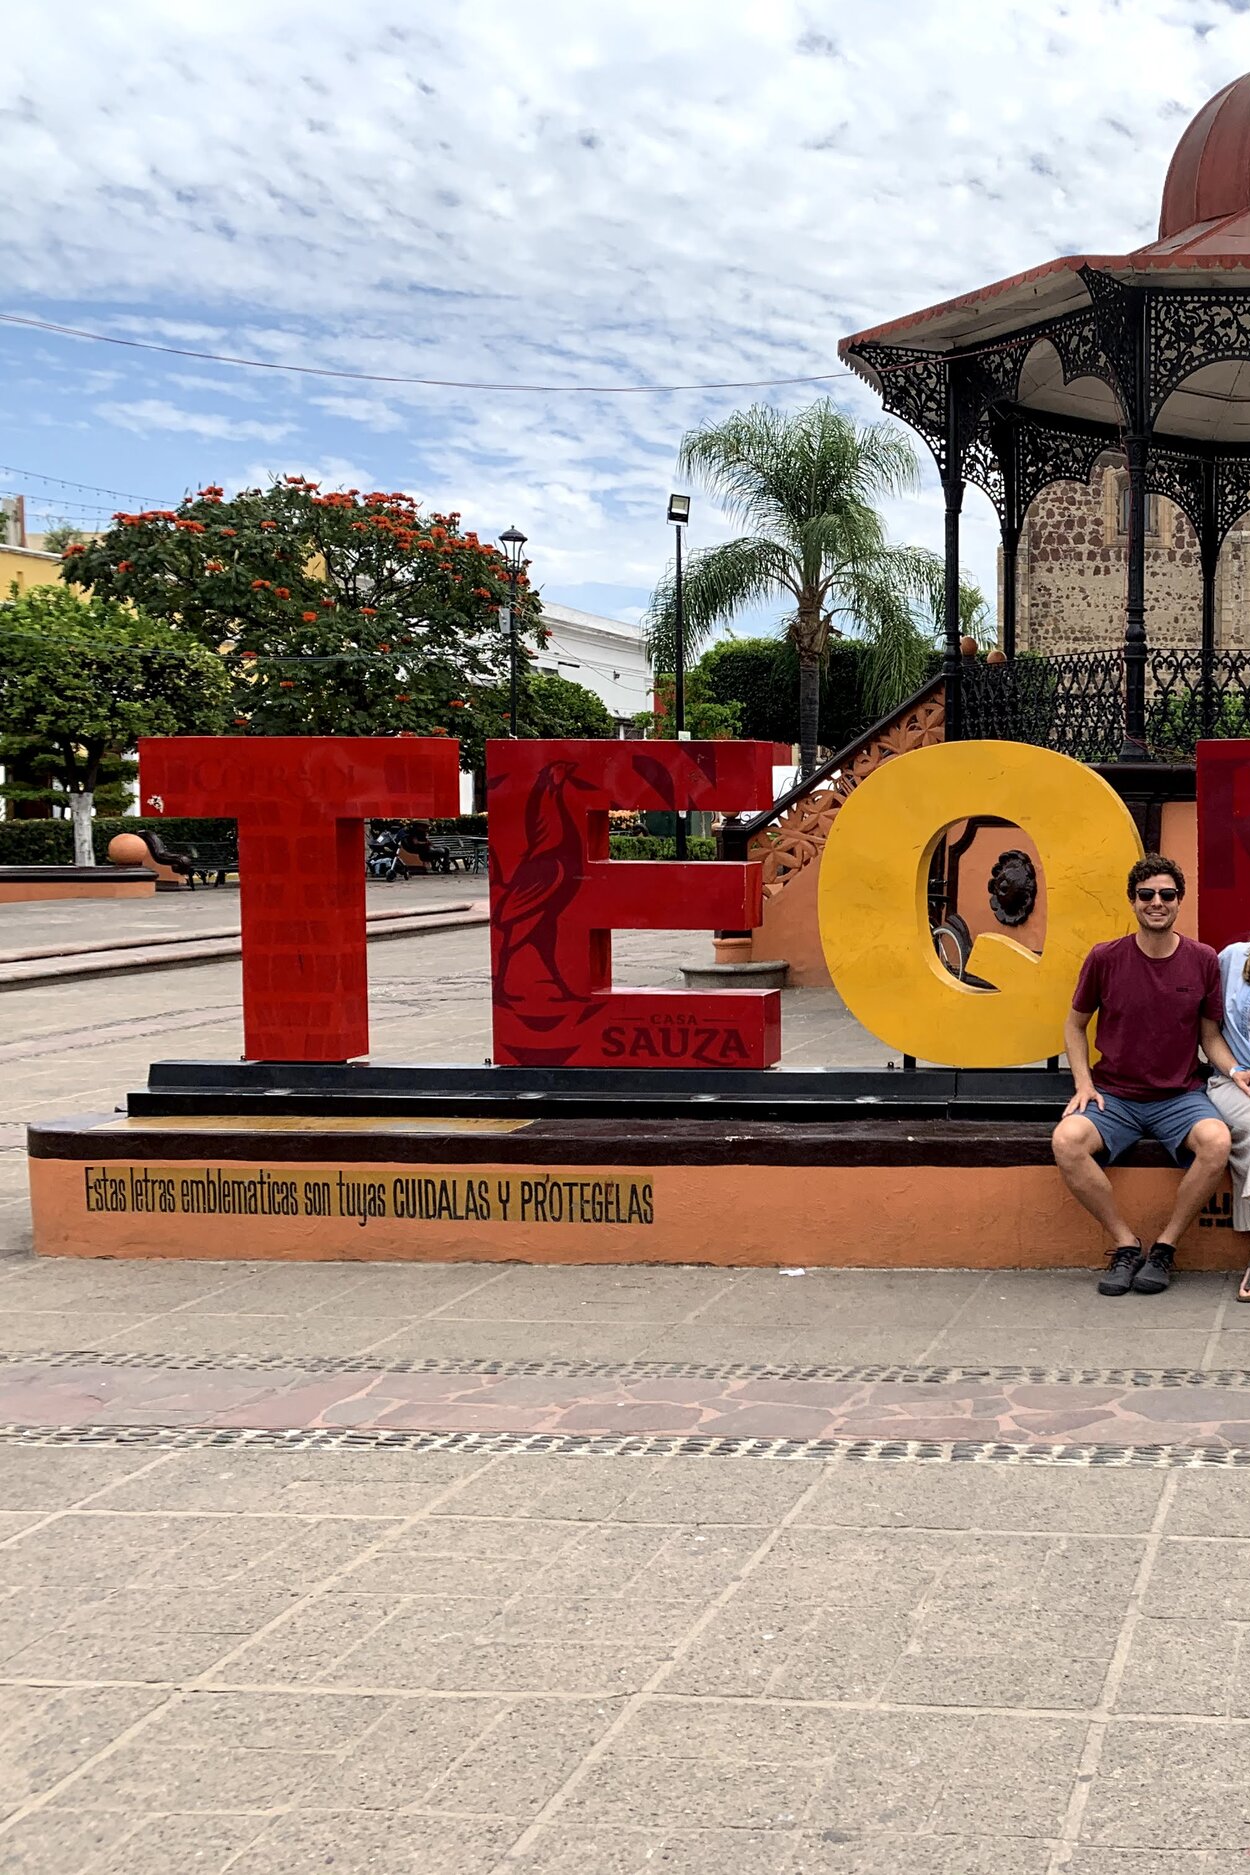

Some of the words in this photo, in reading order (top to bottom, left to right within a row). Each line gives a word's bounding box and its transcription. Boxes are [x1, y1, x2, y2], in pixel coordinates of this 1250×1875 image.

[651, 1014, 698, 1025] CASA
[601, 1026, 750, 1066] SAUZA
[84, 1166, 126, 1212] Estas
[130, 1167, 175, 1213] letras
[181, 1168, 298, 1216] emblematicas
[304, 1181, 331, 1216] son
[336, 1171, 386, 1227] tuyas
[393, 1177, 491, 1221] CUIDALAS
[498, 1180, 510, 1222] Y
